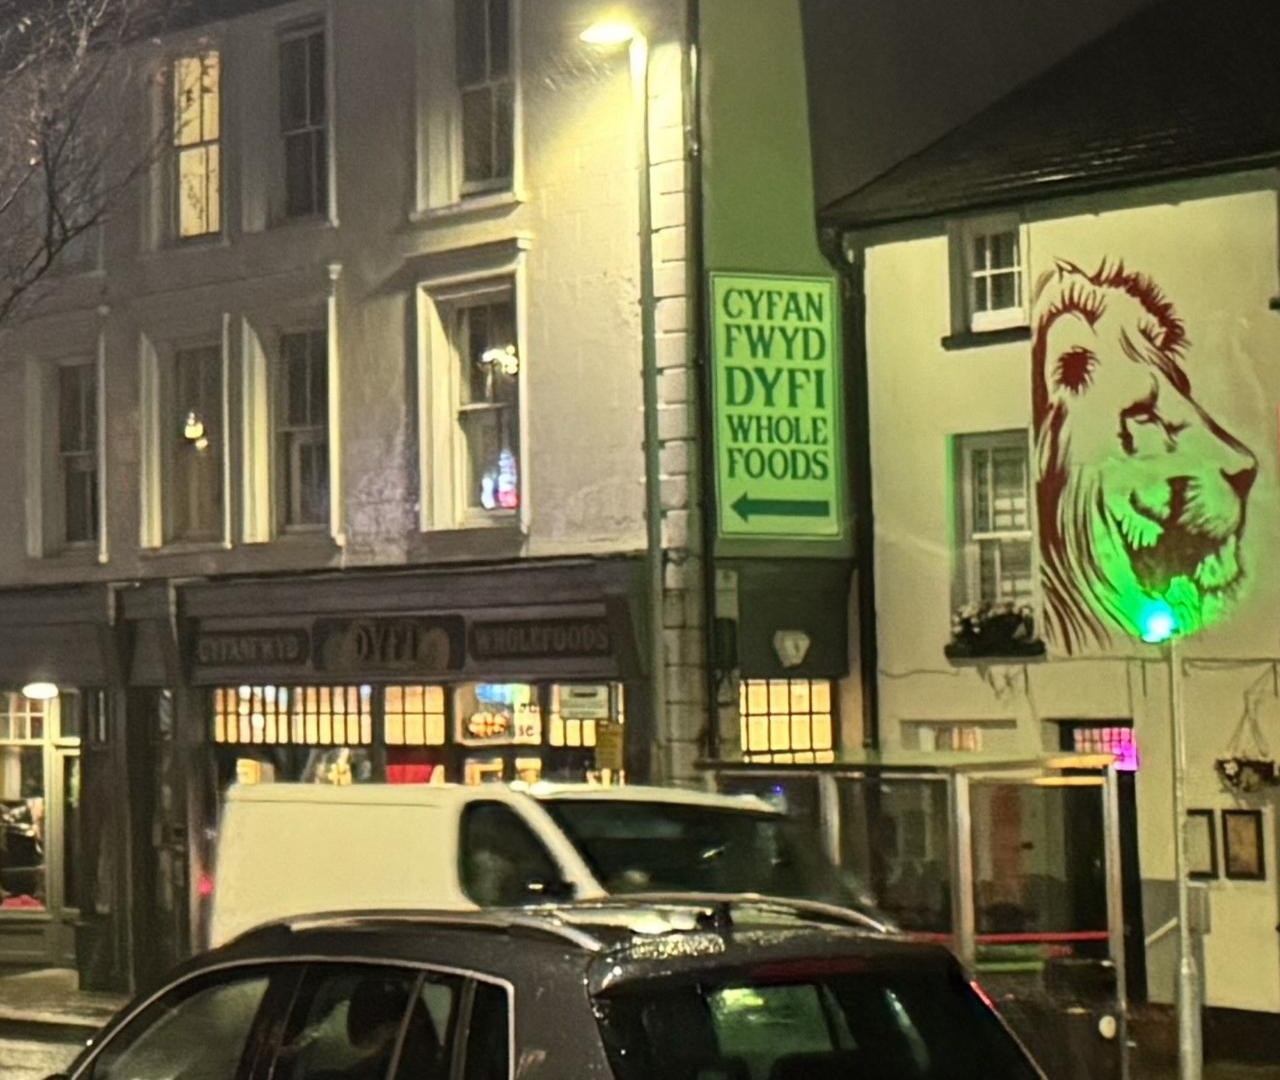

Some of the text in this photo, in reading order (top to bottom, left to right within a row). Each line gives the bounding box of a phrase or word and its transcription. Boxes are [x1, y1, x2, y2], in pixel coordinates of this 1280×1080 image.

[723, 288, 823, 322] CYFAN
[725, 324, 826, 361] FWYD
[725, 366, 826, 409] DYFI
[727, 415, 828, 445] WHOLE
[727, 448, 829, 480] FOODS
